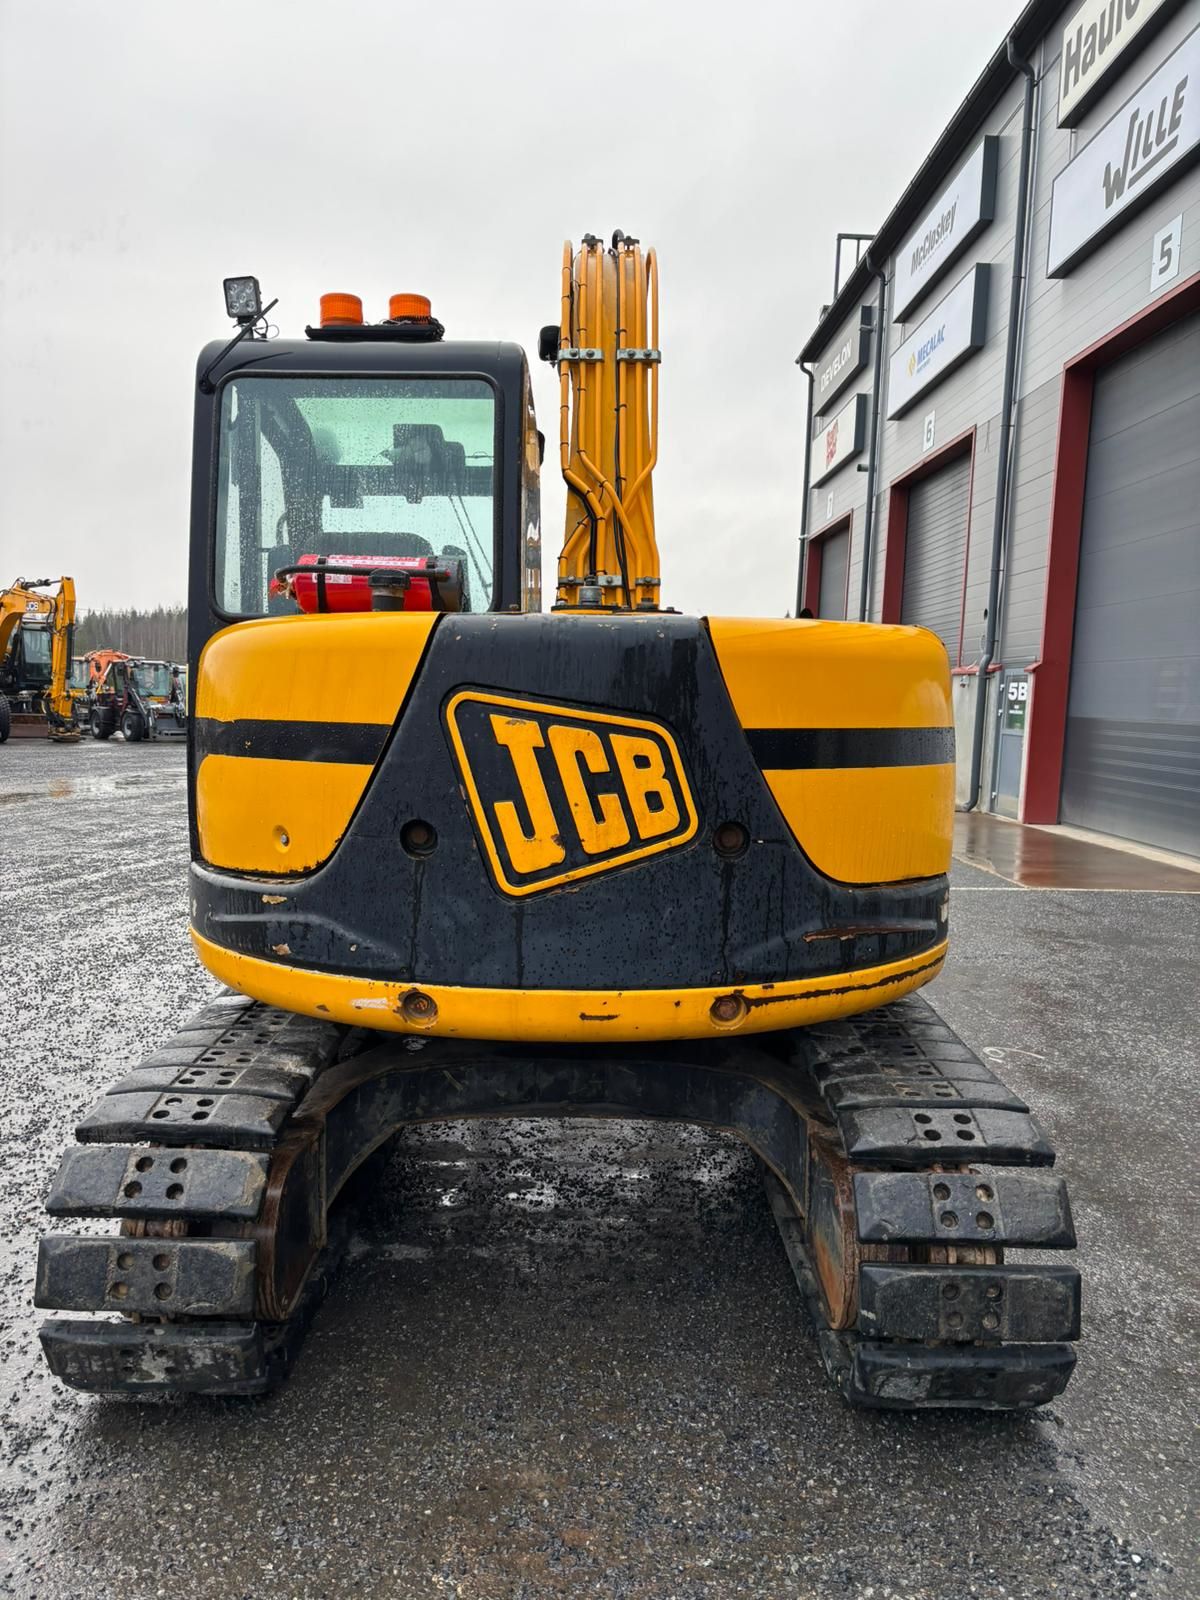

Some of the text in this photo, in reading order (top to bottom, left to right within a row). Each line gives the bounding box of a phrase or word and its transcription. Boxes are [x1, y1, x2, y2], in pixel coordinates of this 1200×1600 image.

[910, 201, 957, 276] McCloskey
[1158, 233, 1173, 276] 5
[820, 338, 852, 393] DEVELON
[917, 323, 946, 367] MECALAC
[926, 419, 933, 444] 6
[1008, 682, 1028, 701] 5B
[489, 713, 681, 874] JCB
